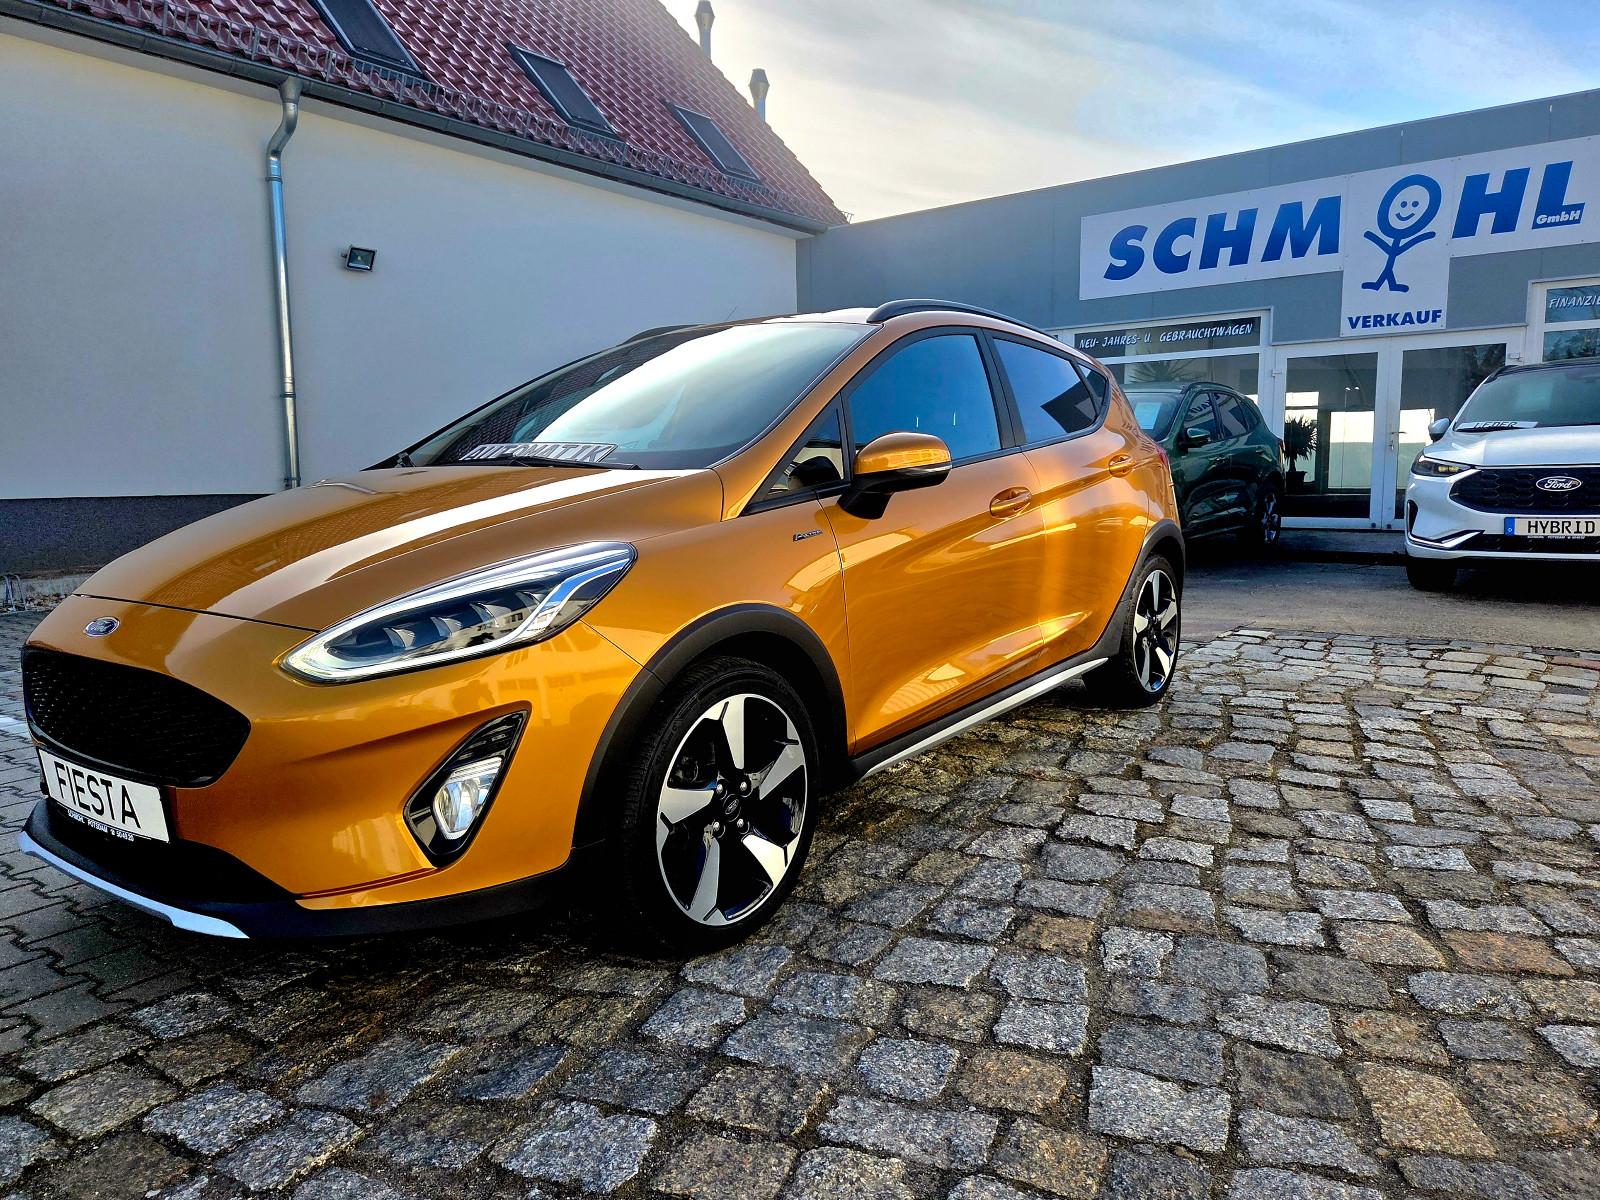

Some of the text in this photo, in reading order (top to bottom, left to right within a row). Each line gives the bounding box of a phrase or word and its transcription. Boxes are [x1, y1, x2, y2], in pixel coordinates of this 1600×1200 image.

[1536, 209, 1581, 225] GmbH
[1347, 309, 1443, 330] VERKAUF
[1079, 337, 1099, 349] NEU-
[1102, 334, 1141, 348] JAHRES-
[1159, 323, 1253, 342] GEBRAUCHTWAGEN
[1544, 478, 1573, 489] Ford
[1527, 520, 1596, 535] HYBRID
[54, 760, 141, 829] FIESTA
